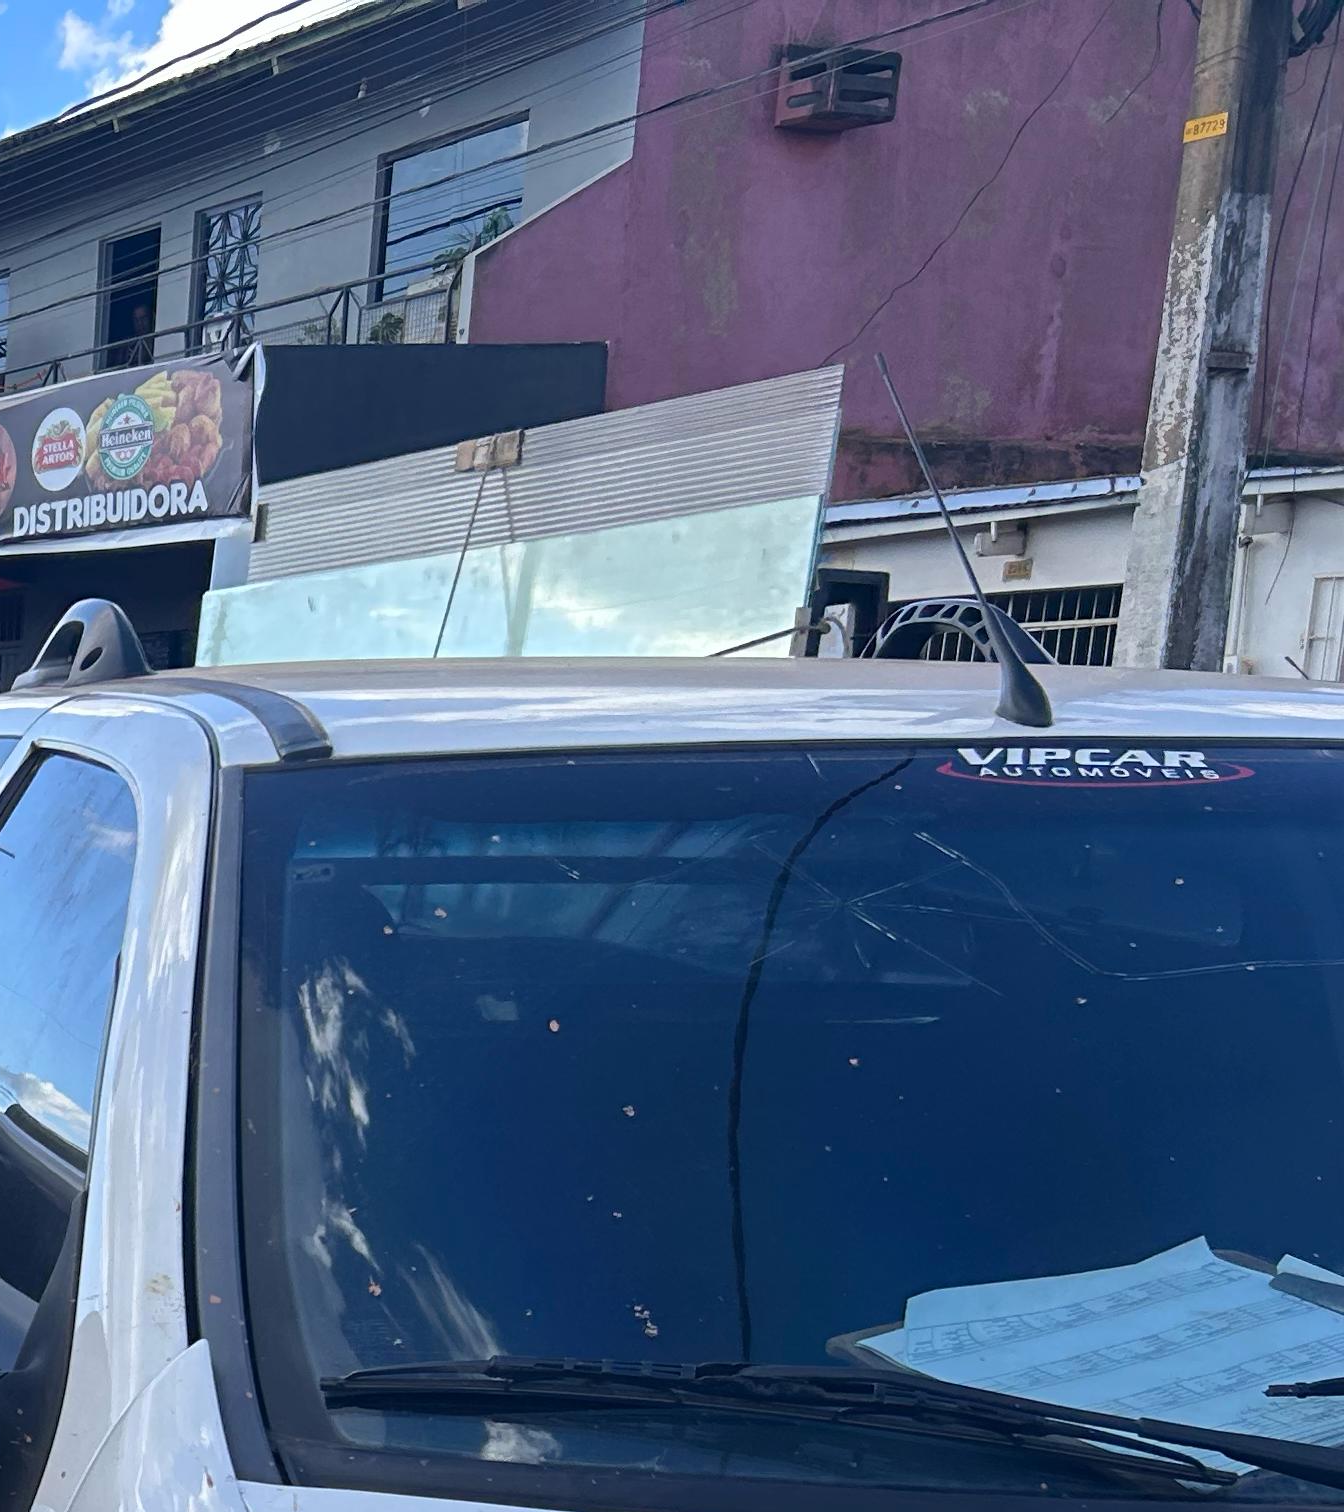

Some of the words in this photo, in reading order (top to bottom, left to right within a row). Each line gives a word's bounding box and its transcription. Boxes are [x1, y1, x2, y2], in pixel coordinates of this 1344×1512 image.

[43, 439, 74, 454] STELLA
[101, 429, 152, 448] Heineken
[42, 450, 75, 465] ARTOIS
[13, 480, 209, 537] DISTRIBUIDORA
[957, 748, 1208, 768] VIPCAR
